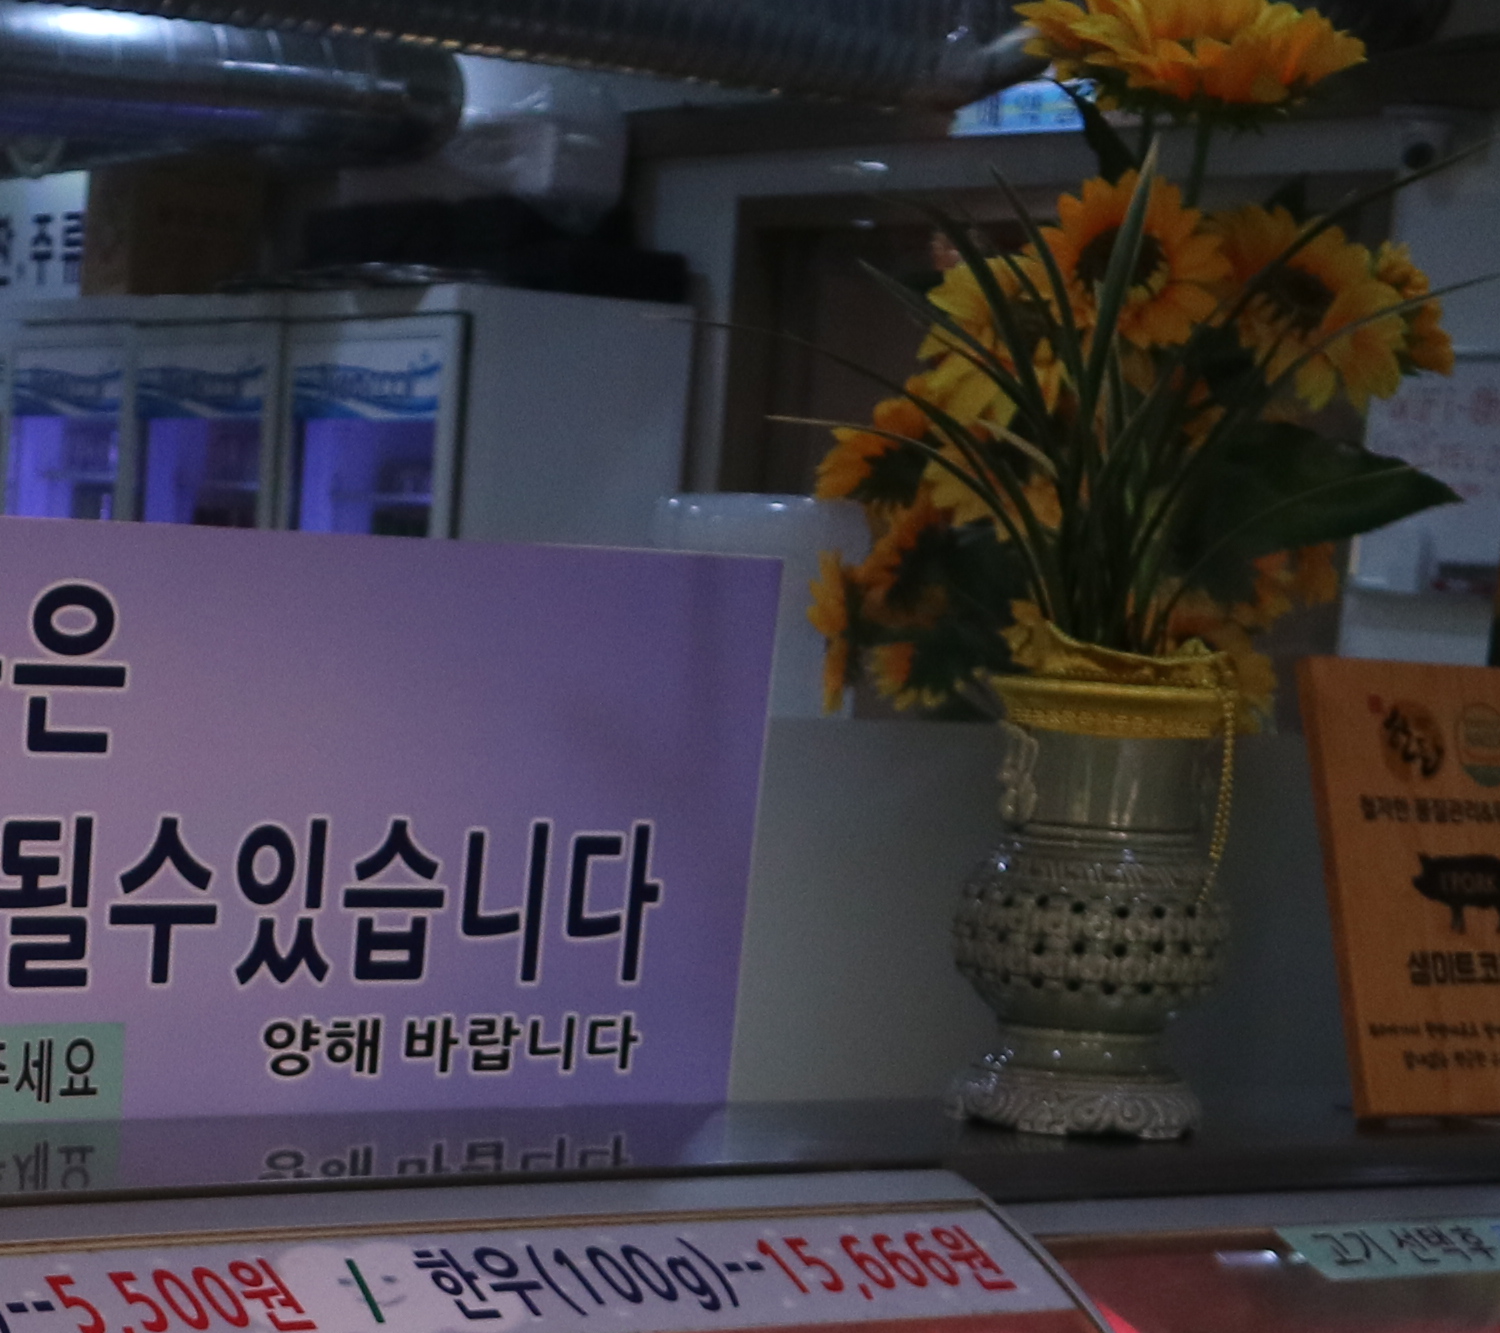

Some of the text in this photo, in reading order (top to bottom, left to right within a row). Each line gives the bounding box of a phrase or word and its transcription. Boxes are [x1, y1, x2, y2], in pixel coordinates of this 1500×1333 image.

[262, 1016, 641, 1079] 양해 바랍니다
[1310, 1230, 1398, 1267] 고기
